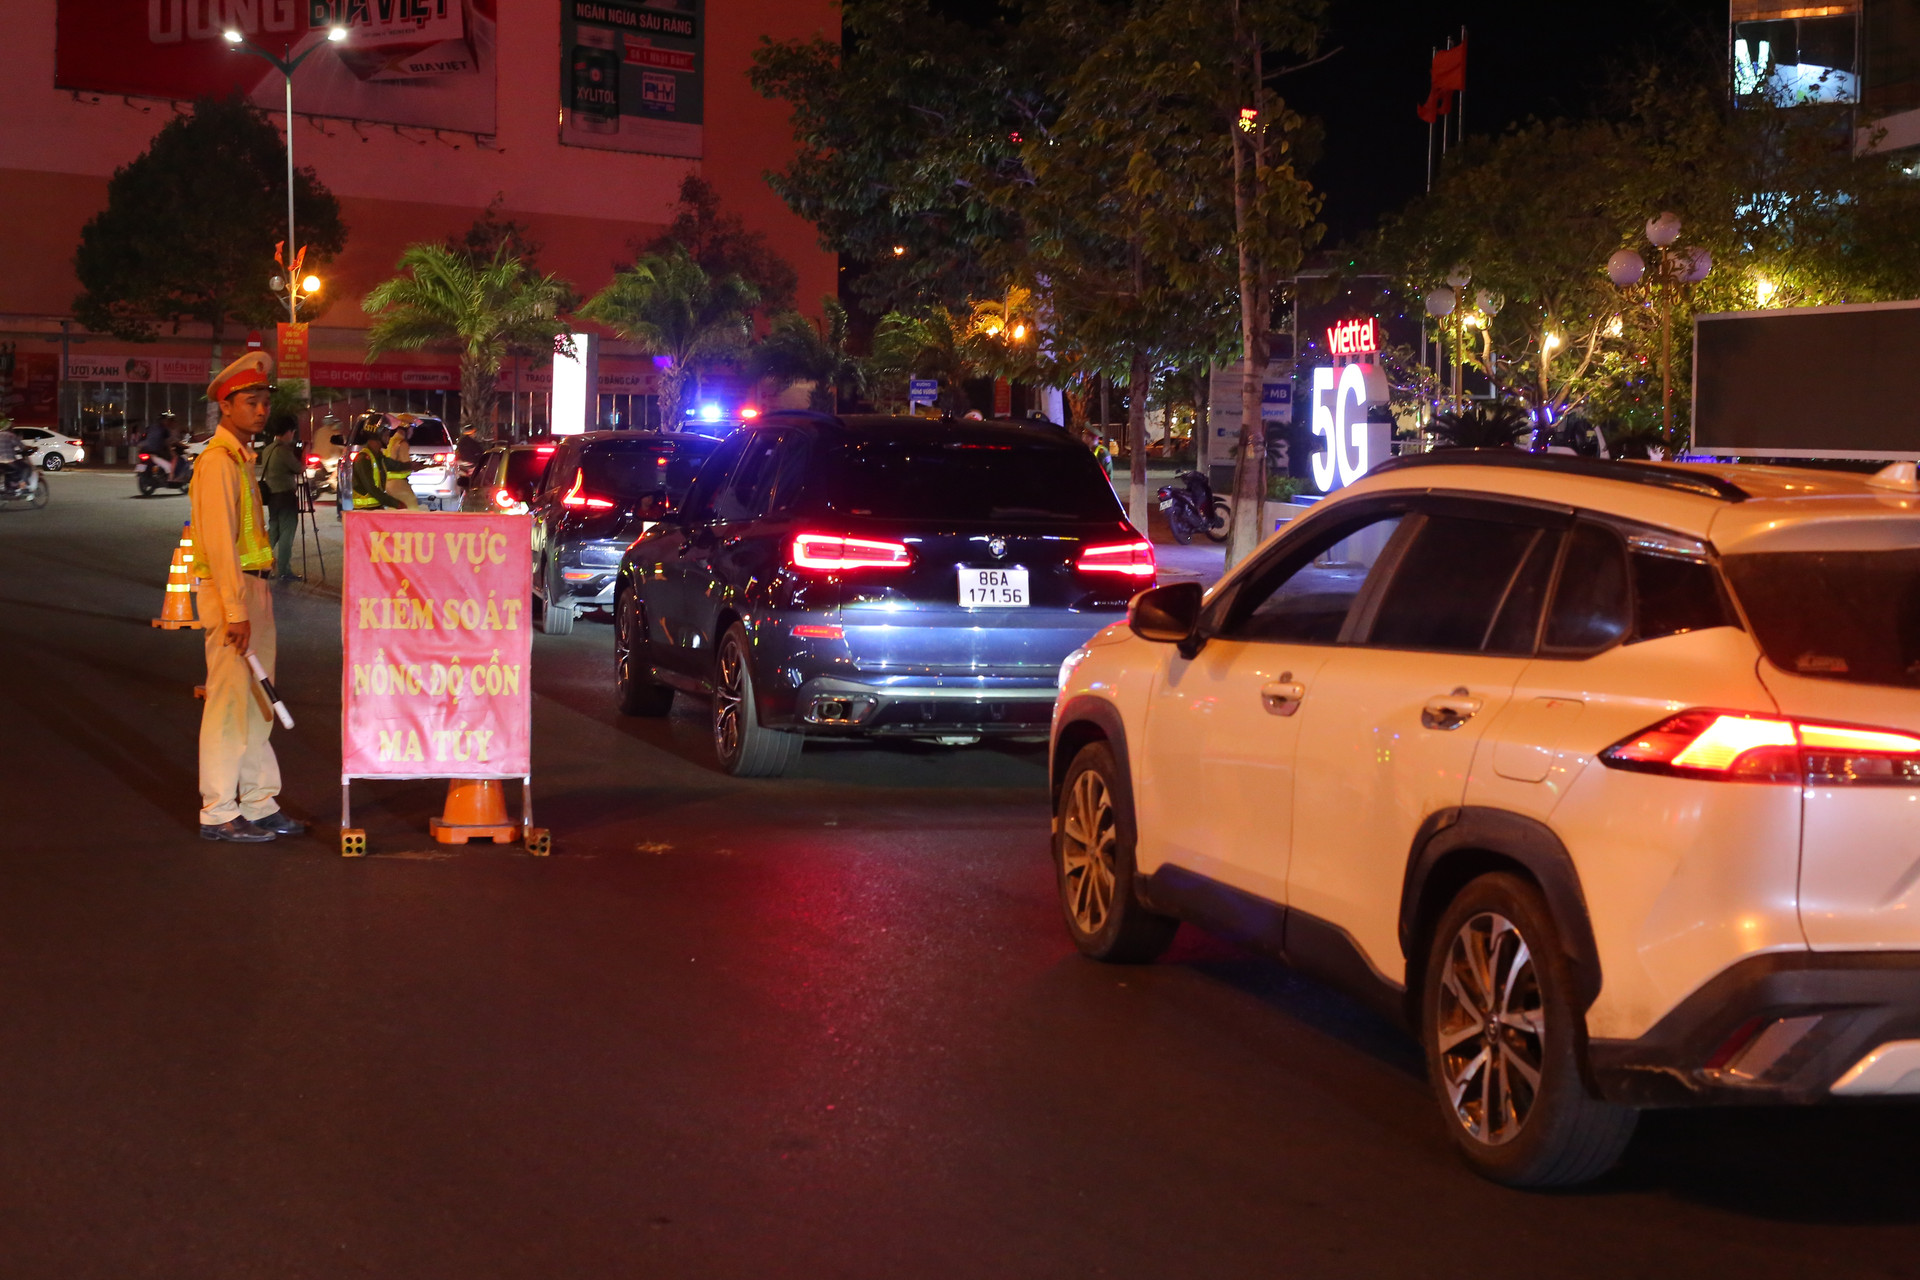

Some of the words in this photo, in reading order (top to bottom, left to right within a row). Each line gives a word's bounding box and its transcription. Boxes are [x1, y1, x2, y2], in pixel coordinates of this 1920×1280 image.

[639, 13, 661, 31] SÂU
[576, 86, 617, 105] XYLITOL
[1327, 316, 1376, 355] viettel
[91, 366, 120, 377] XANH
[364, 371, 398, 382] ONLINE
[1270, 389, 1288, 399] MB
[1311, 362, 1368, 493] 5G
[369, 531, 436, 563] KHU
[444, 527, 507, 573] VỰC
[979, 571, 1009, 586] 86A
[358, 579, 435, 631] KIỂM
[442, 590, 522, 631] SOÁT
[969, 588, 1022, 603] 171.56
[353, 648, 423, 696] NỒNG
[430, 655, 467, 705] ĐỘ
[470, 648, 521, 696] CỒN
[379, 730, 425, 763] MA
[432, 721, 494, 763] TÚY
